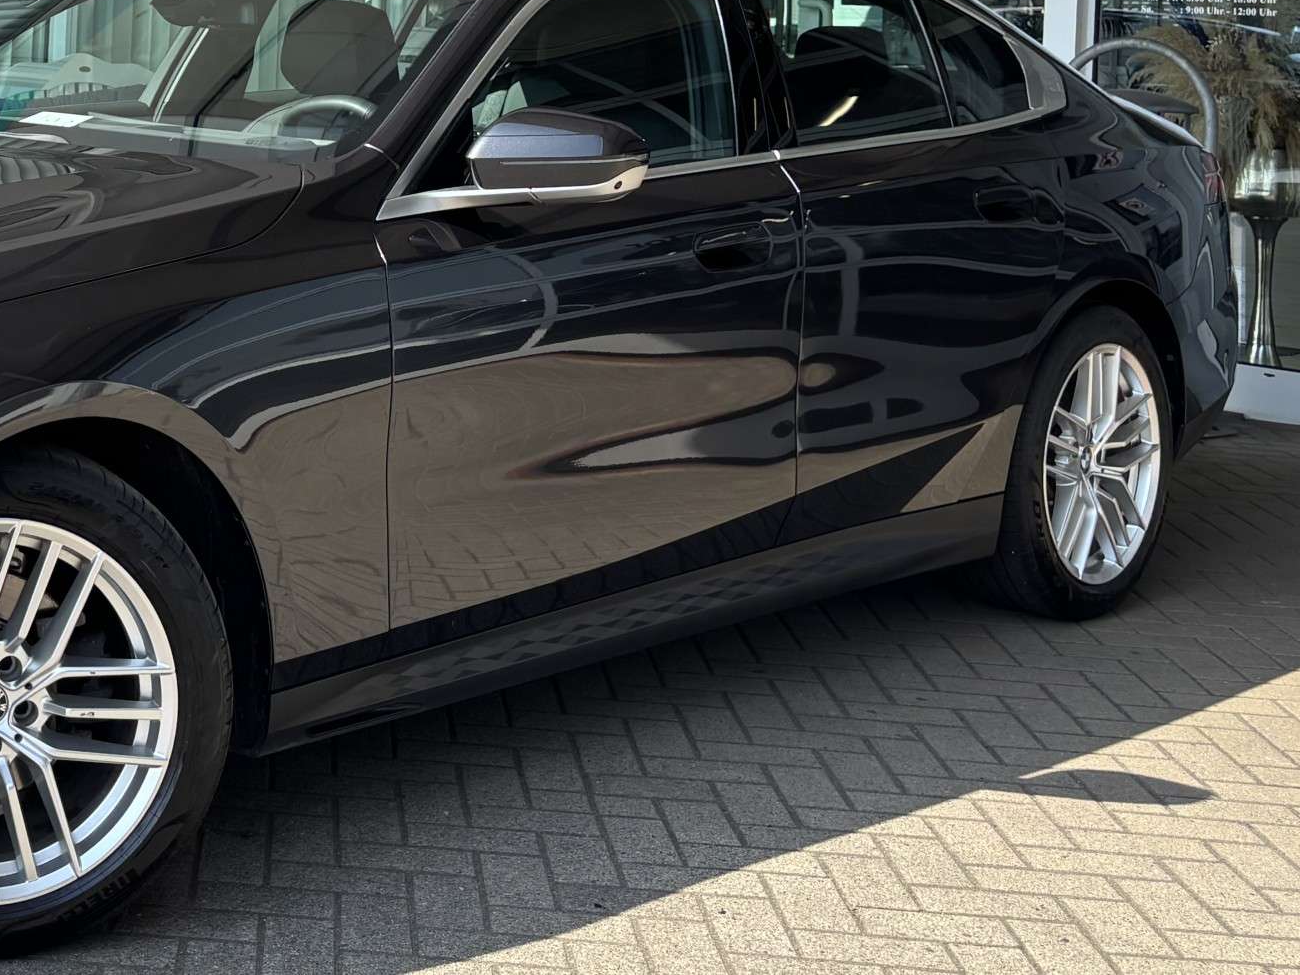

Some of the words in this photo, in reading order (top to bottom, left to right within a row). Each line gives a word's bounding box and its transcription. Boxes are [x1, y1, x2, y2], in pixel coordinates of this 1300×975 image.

[1186, 6, 1205, 15] 9:00
[1233, 7, 1257, 16] 12:00
[1259, 8, 1277, 17] Uhr
